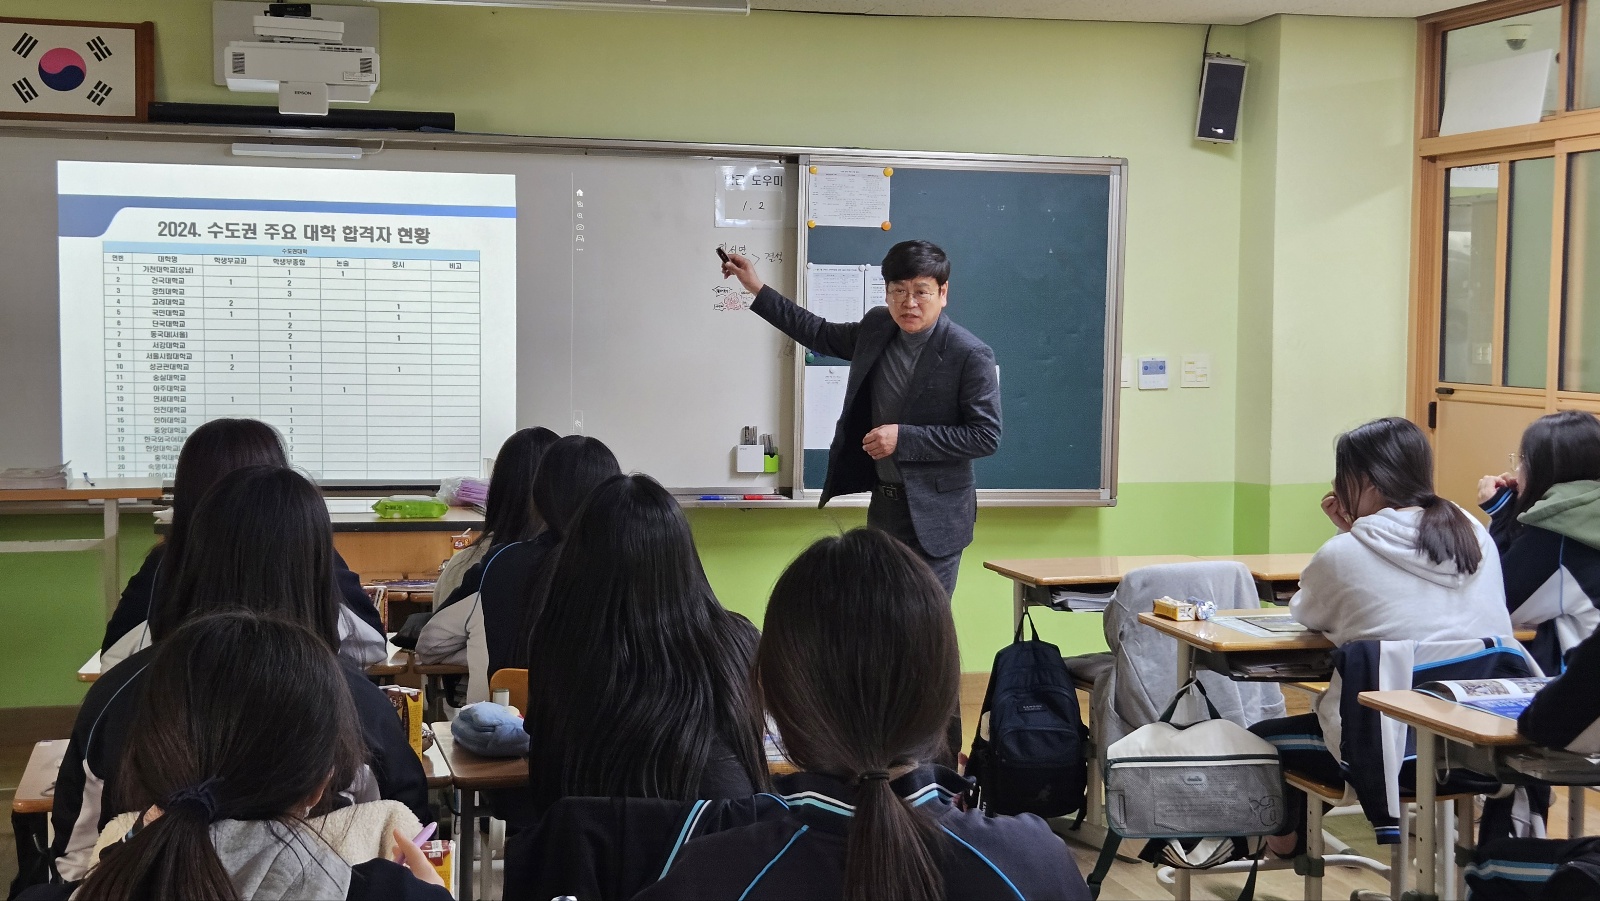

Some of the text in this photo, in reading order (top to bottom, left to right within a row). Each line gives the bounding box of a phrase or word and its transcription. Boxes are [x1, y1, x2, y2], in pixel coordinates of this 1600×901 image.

[752, 175, 783, 186] 도우미
[158, 221, 431, 245] 2024. 수도권 주요 대학 합격자 현황
[273, 258, 306, 266] 학생부종합
[152, 276, 185, 284] 건국대학교
